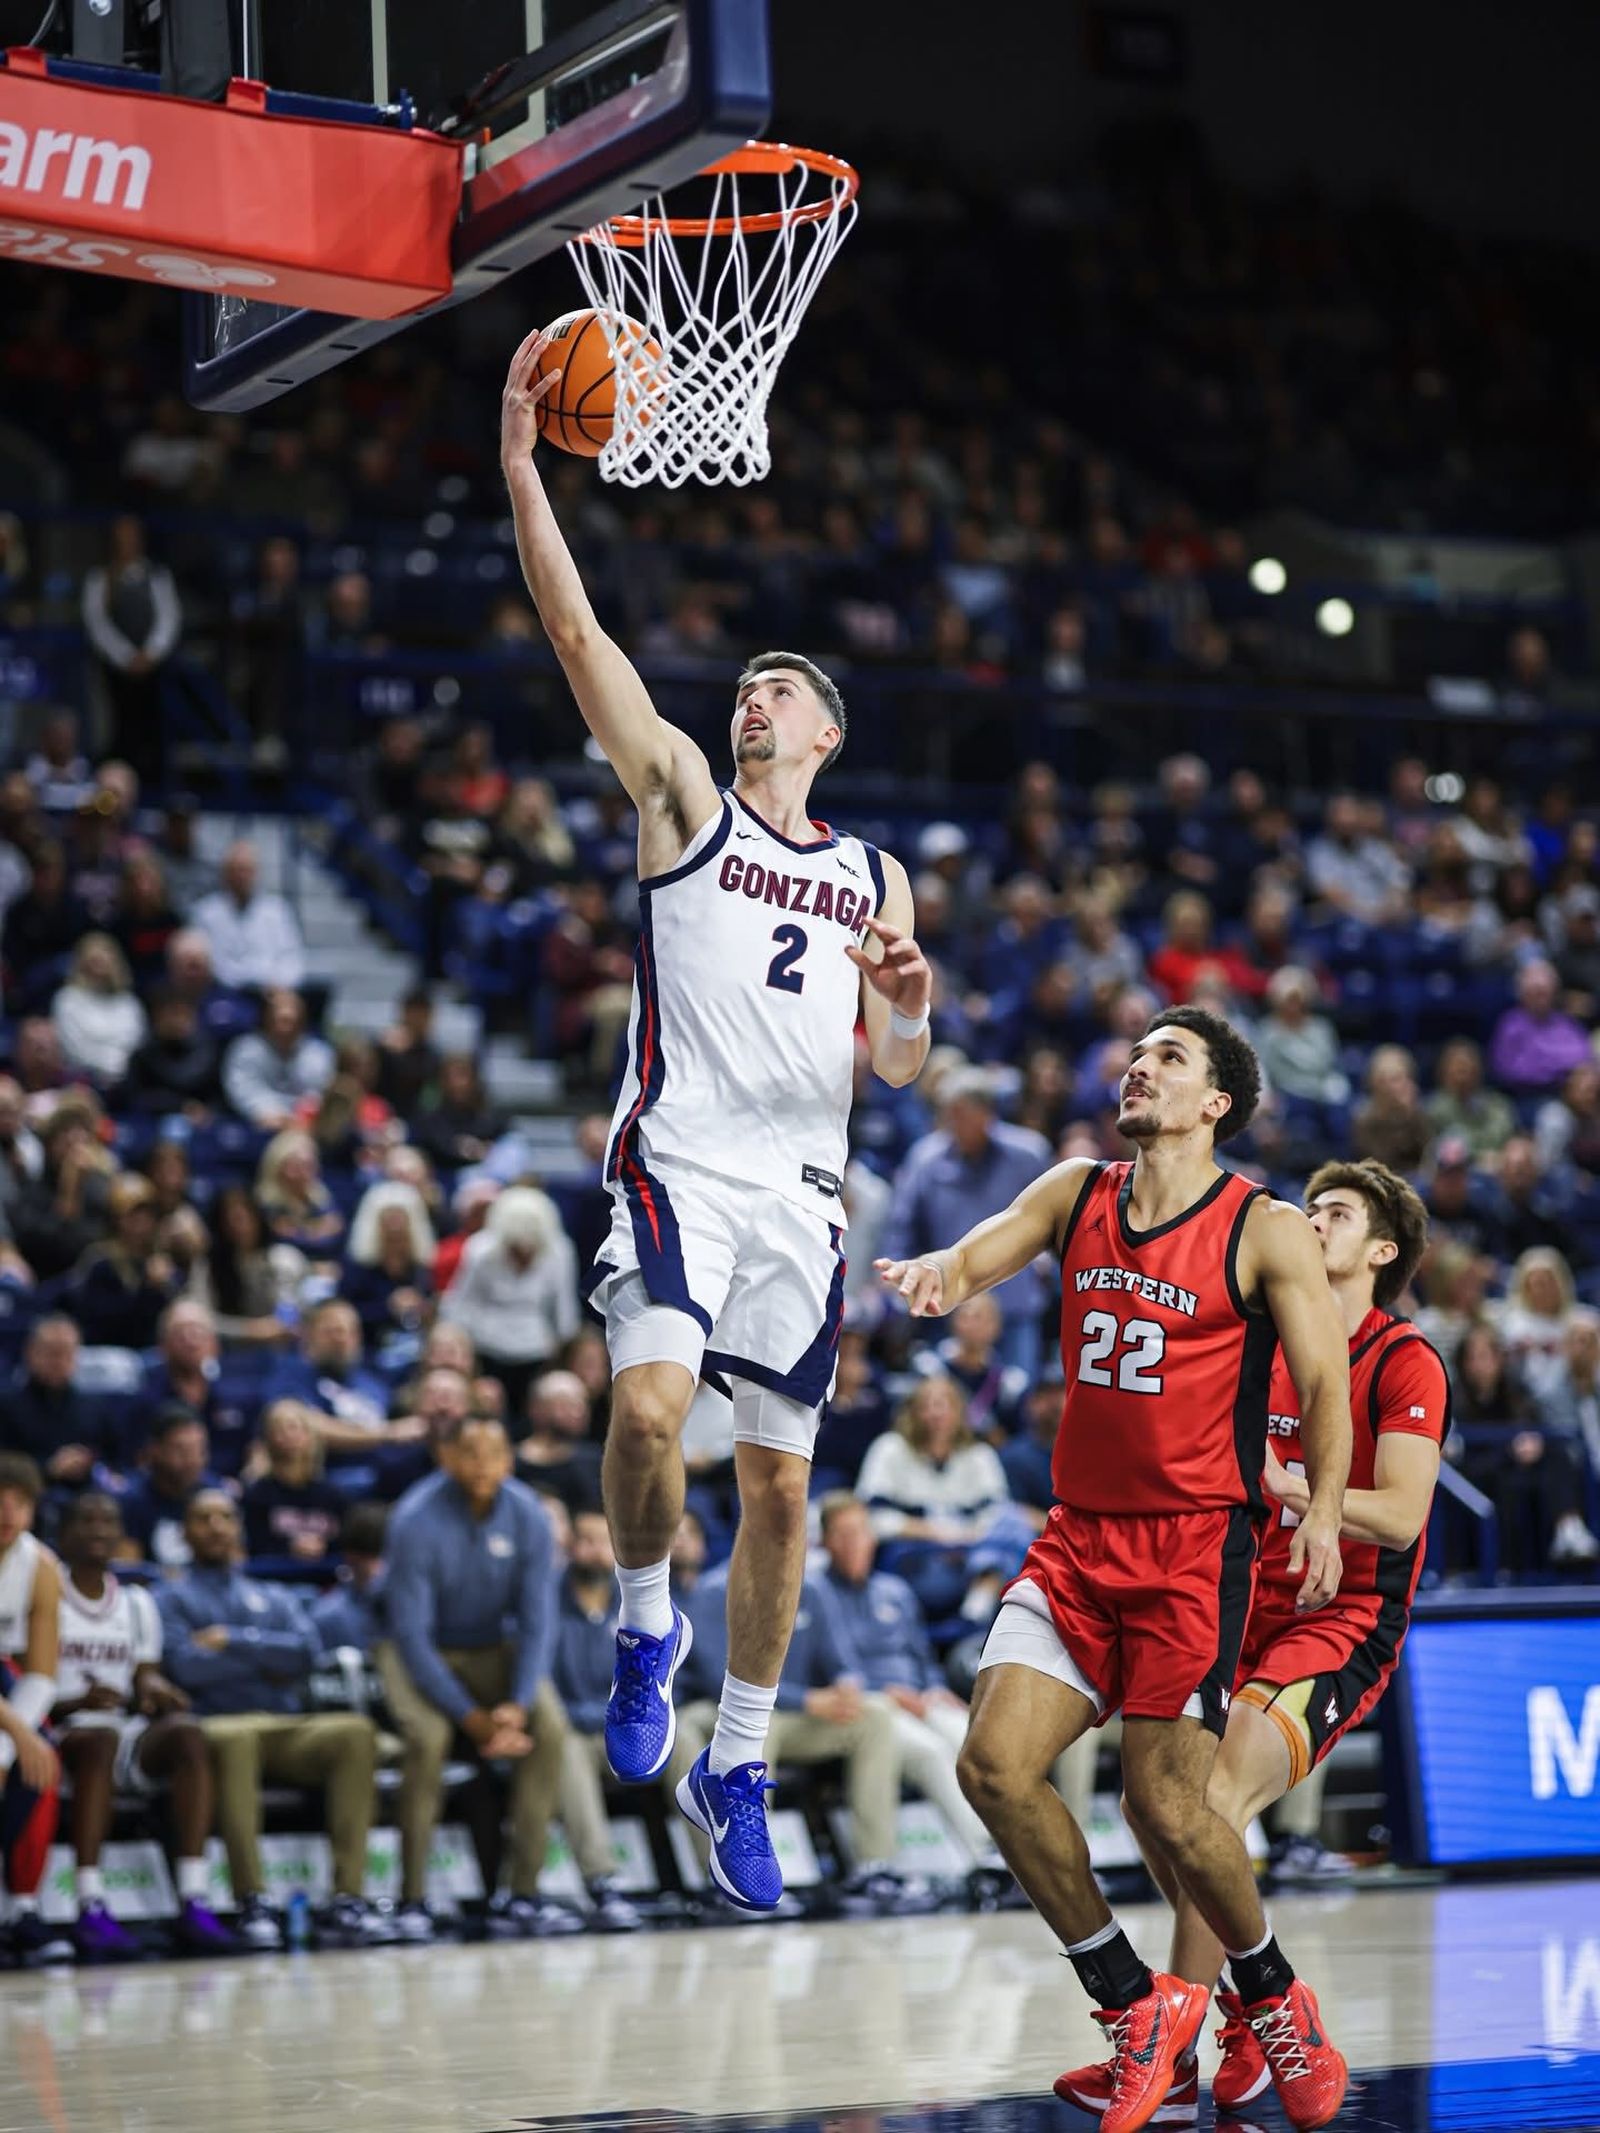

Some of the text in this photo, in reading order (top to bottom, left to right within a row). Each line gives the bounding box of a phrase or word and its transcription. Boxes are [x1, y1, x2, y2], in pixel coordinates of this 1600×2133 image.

[718, 854, 871, 938] GONZAGA
[765, 923, 809, 996] 2
[1075, 1266, 1199, 1319] WESTERN
[1077, 1308, 1167, 1396] 22
